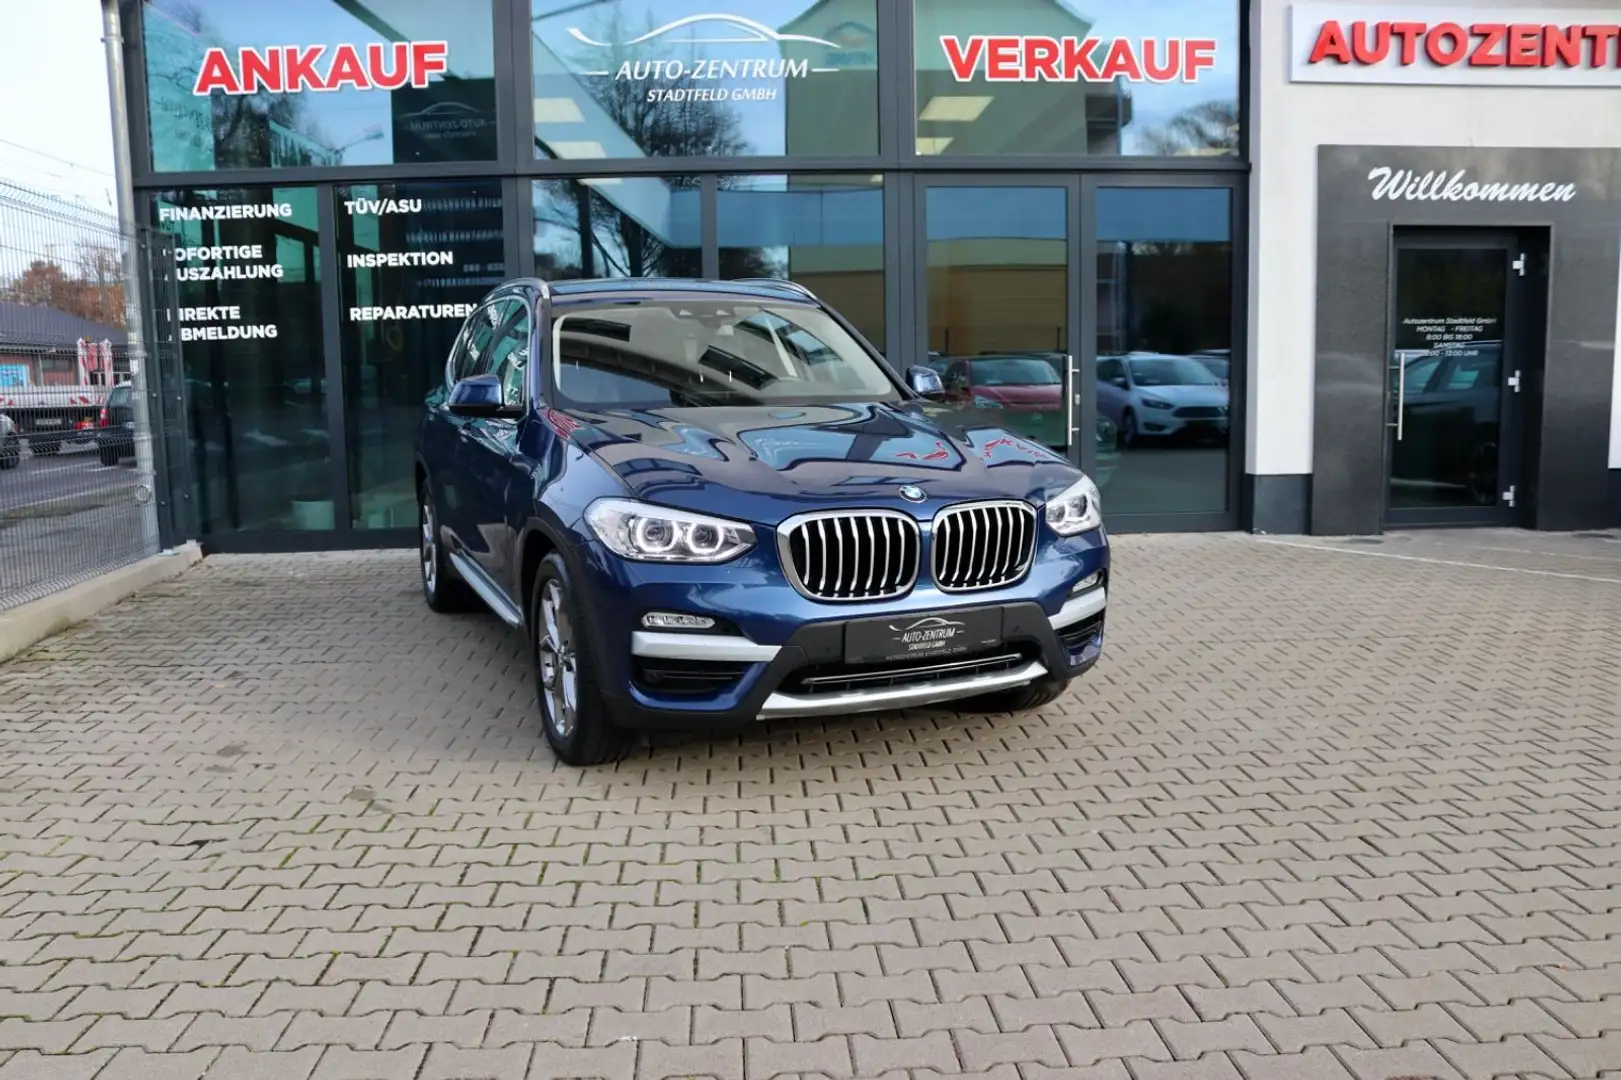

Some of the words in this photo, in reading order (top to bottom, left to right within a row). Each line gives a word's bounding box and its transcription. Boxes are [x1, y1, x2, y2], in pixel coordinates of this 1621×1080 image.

[1309, 20, 1621, 68] AUTOZENT
[193, 40, 447, 96] ANKAUF
[940, 35, 1217, 84] VERKAUF
[615, 58, 809, 81] AUTO-ZENTRUM
[647, 89, 728, 102] STADTFELD
[731, 87, 777, 101] GMBH
[1368, 166, 1576, 202] Willkommen
[159, 203, 293, 221] FINANZIERUNG
[344, 198, 422, 215] TÜV/ASU
[347, 251, 453, 268] INSPEKTION
[164, 264, 284, 281] USZAHLUNG
[167, 306, 240, 321] IREKTE
[350, 303, 477, 321] REPARATUREN
[168, 324, 278, 341] BMELDUNG
[902, 628, 955, 643] AUTO-ZENTRUM
